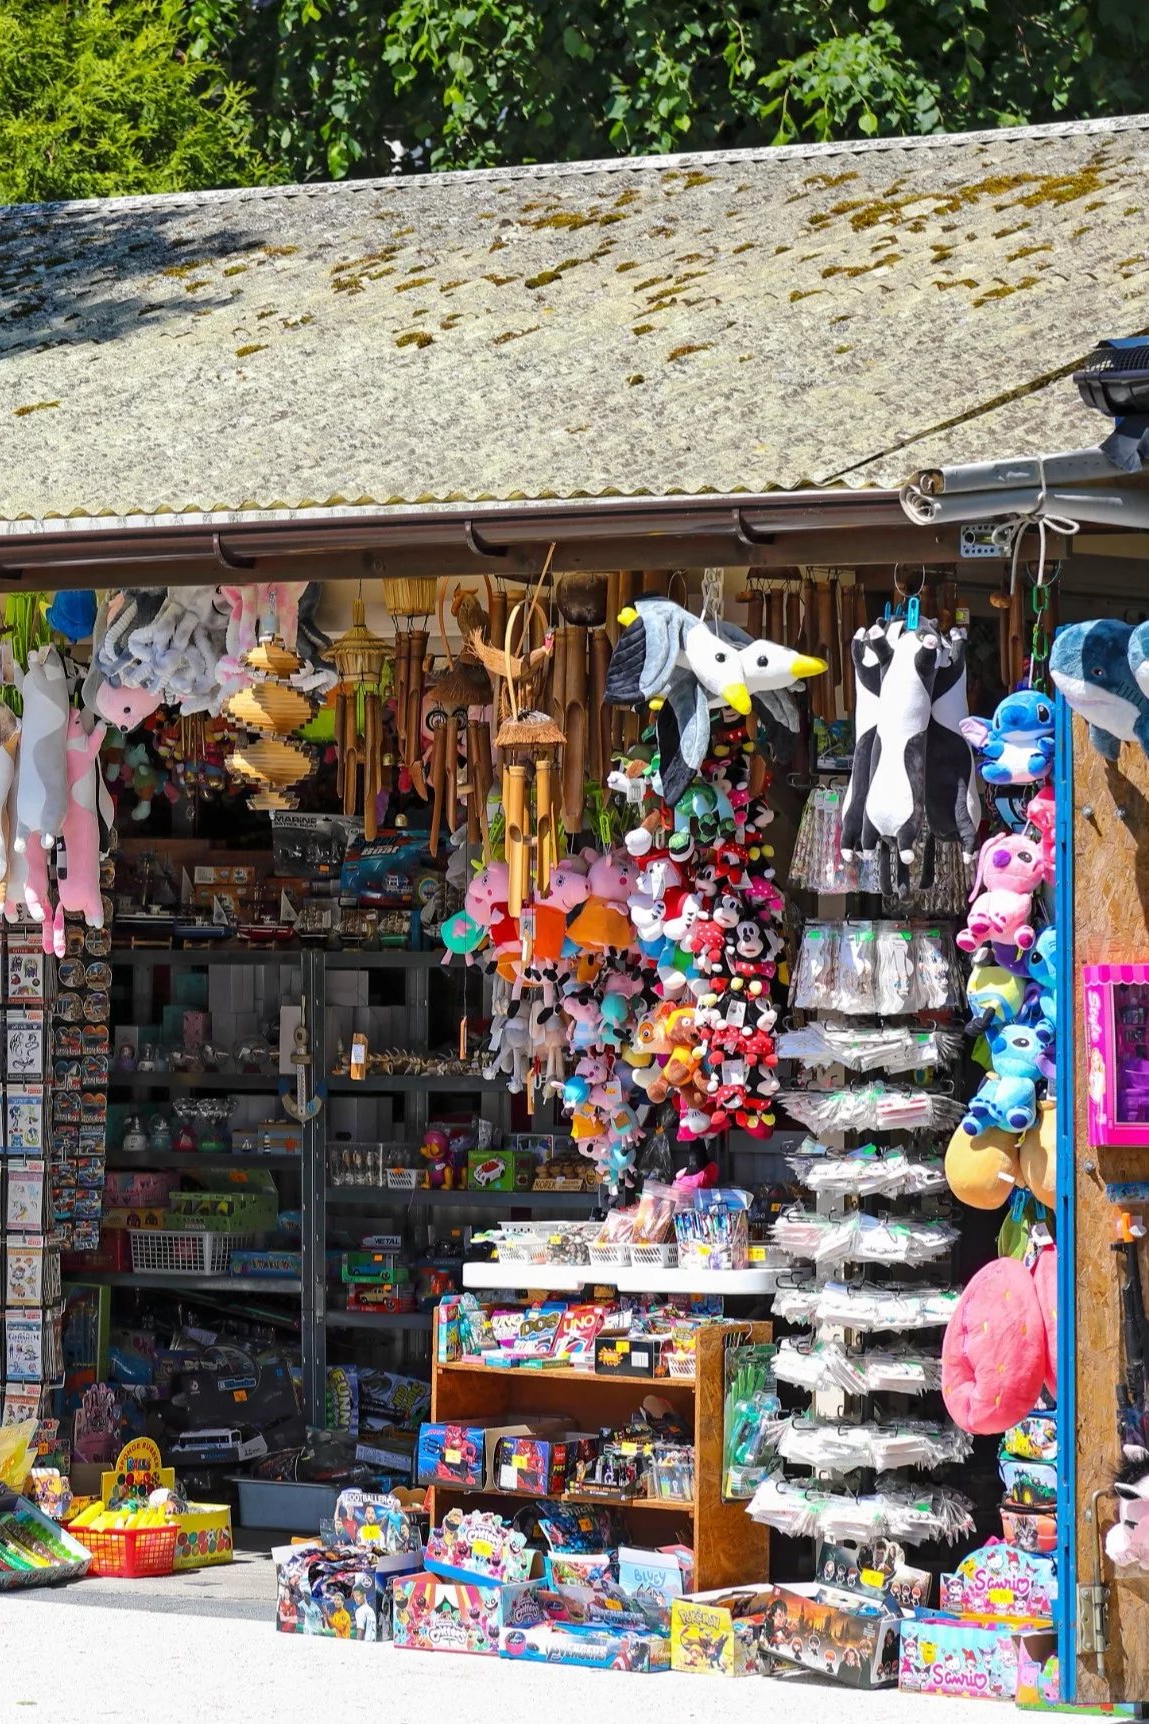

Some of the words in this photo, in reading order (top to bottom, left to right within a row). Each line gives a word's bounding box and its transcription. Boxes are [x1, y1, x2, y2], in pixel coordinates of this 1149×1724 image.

[273, 815, 317, 824] MARINE
[1087, 989, 1103, 1043] Style
[520, 1312, 561, 1336] DOS
[563, 1314, 596, 1332] UNO
[118, 1441, 141, 1471] SPONGE
[142, 1441, 160, 1469] RUBBER
[127, 1456, 152, 1472] BALLS
[559, 1502, 594, 1518] Stitch
[634, 1569, 666, 1588] BLUEY
[974, 1569, 1030, 1595] Sanrio
[546, 1643, 608, 1661] AVENGERS
[932, 1664, 988, 1690] Sanrio
